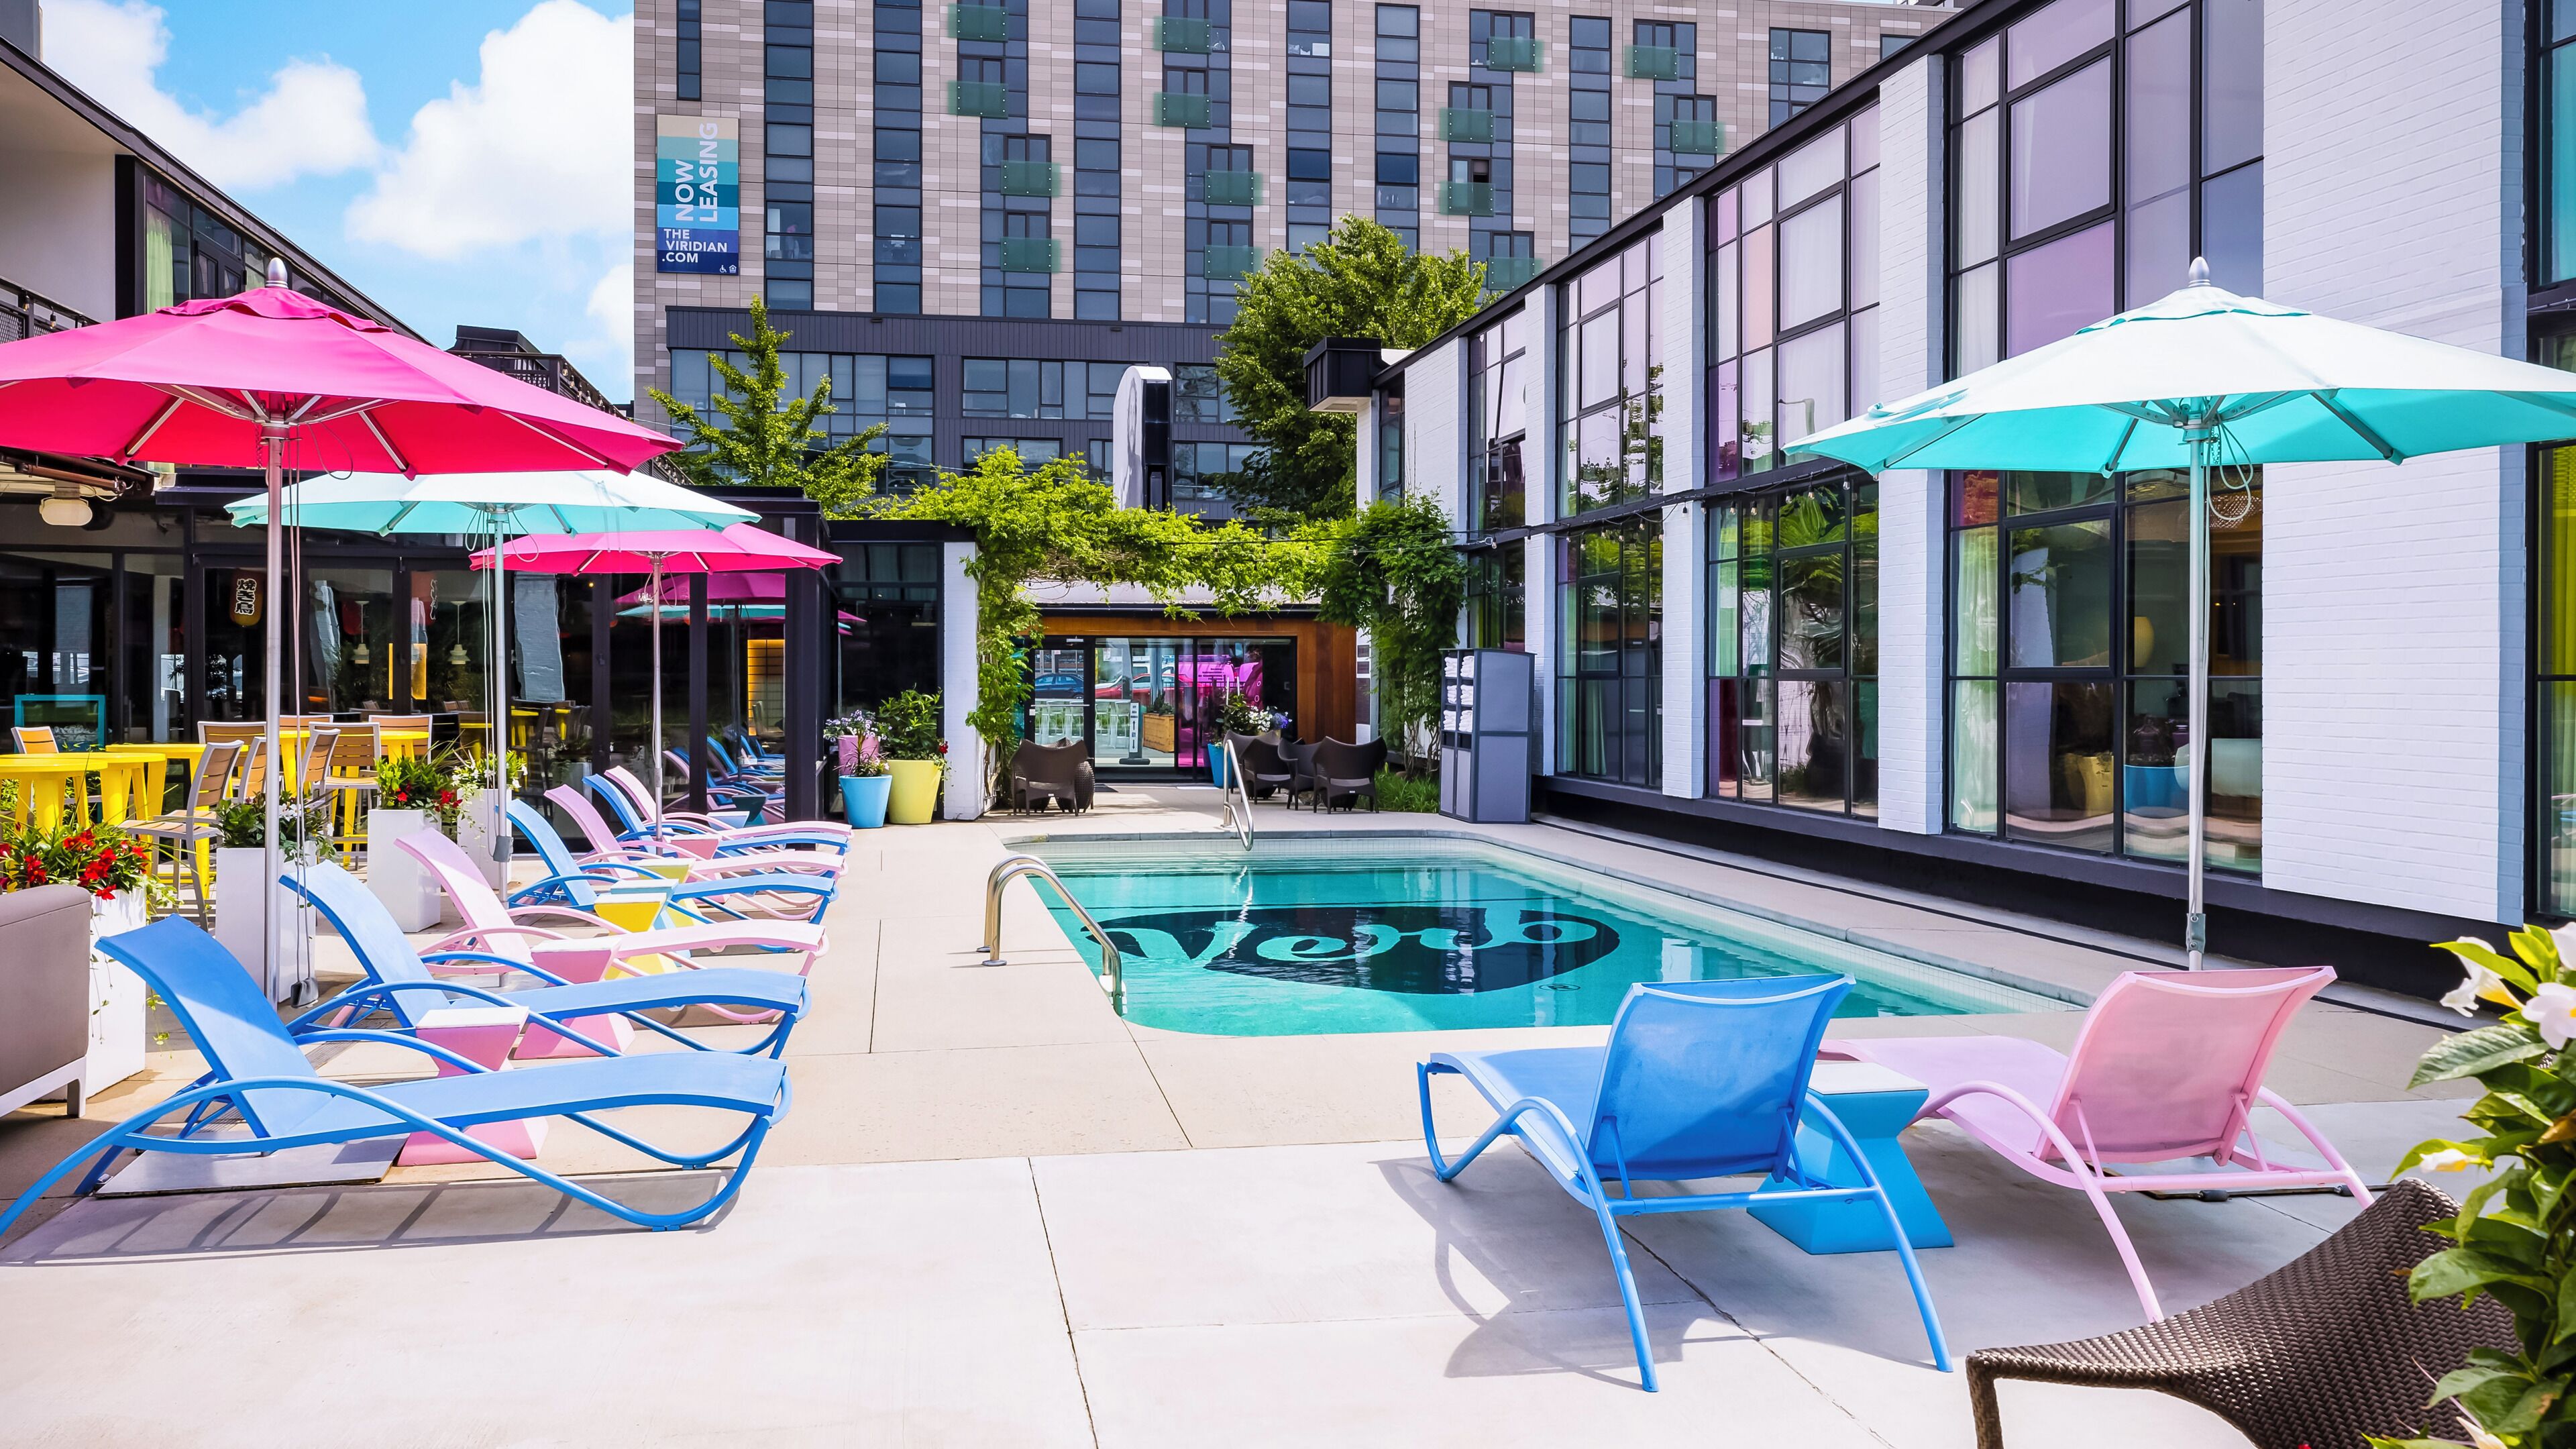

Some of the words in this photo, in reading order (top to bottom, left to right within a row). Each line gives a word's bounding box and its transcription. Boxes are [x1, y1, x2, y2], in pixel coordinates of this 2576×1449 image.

[699, 123, 718, 222] LEASING
[675, 160, 694, 221] NOW
[663, 228, 690, 239] THE
[662, 252, 698, 263] .COM
[666, 240, 727, 253] VIRIDIAN
[235, 578, 257, 615] 焼き鳥
